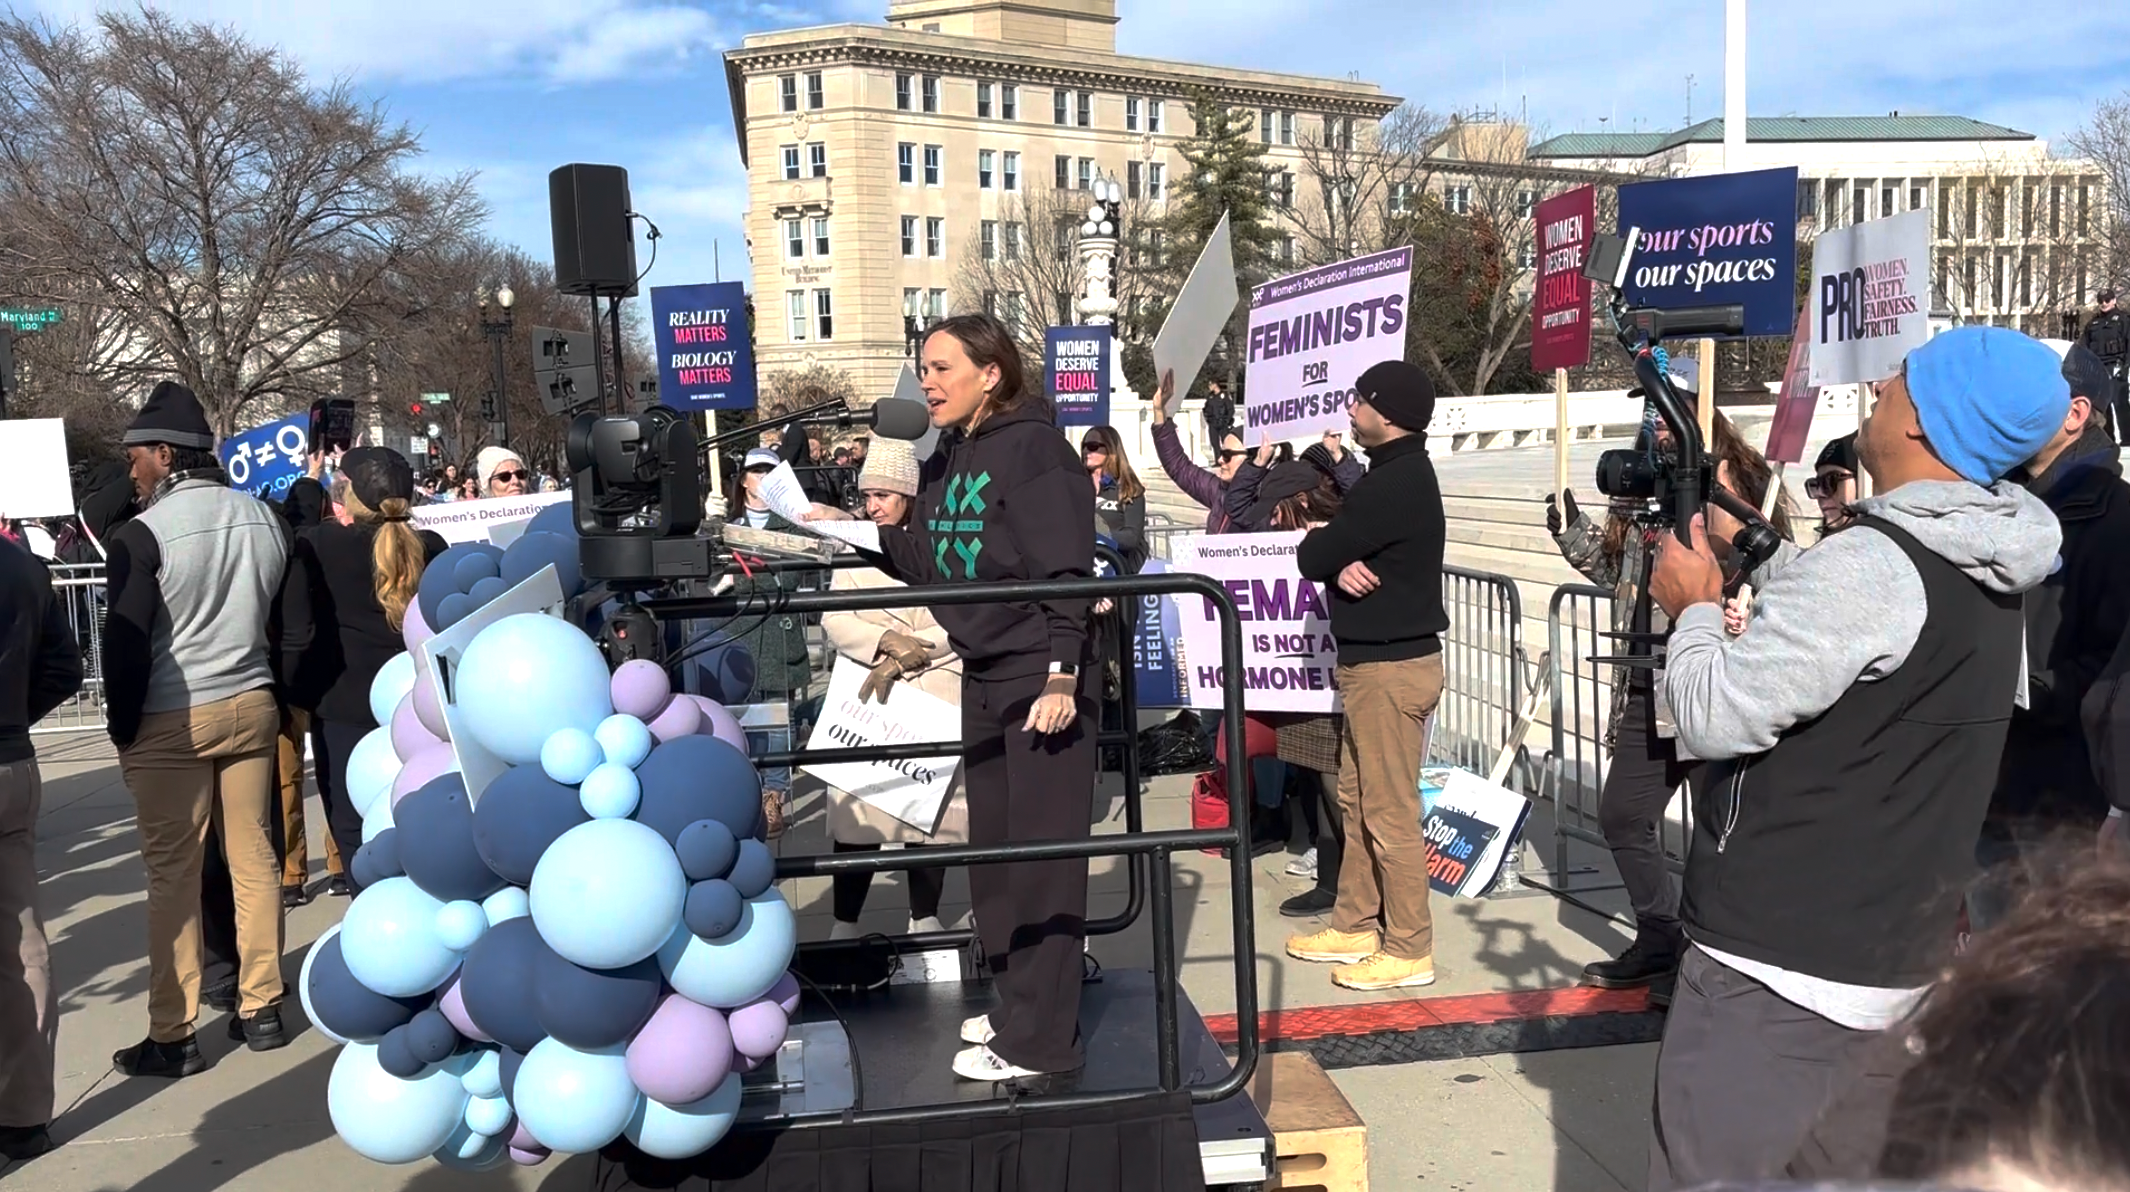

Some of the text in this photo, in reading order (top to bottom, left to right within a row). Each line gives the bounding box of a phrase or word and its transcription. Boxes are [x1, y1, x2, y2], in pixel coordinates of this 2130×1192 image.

[1544, 214, 1583, 250] WOMEN
[1687, 217, 1774, 257] sports
[1544, 245, 1583, 276] DESERVE
[1864, 258, 1909, 282] WOMEN.
[1270, 253, 1405, 298] Women's Declaration International
[1635, 257, 1777, 293] our spaces
[1543, 272, 1581, 310] EQUAL
[1864, 278, 1907, 301] SAFETY.
[1, 311, 46, 322] Maryland
[669, 308, 730, 326] REALITY
[1821, 267, 1865, 344] PRO
[1864, 296, 1918, 320] FAIRNESS.
[21, 322, 38, 330] 100
[1249, 294, 1404, 364] FEMINISTS
[1542, 307, 1581, 330] OPPORTUNITY
[1864, 318, 1900, 339] TRUTH.
[674, 326, 727, 344] MATTERS
[671, 350, 737, 369] BIOLOGY
[1056, 340, 1099, 356] WOMEN
[1055, 357, 1099, 371] DESERVE
[1303, 361, 1328, 382] FOR
[679, 367, 732, 386] MATTERS
[1055, 372, 1098, 392] EQUAL
[1055, 392, 1099, 403] OPPORTUNITY
[1248, 387, 1358, 428] WOMEN'S SPO
[418, 503, 545, 527] Women's Declaratio
[1198, 546, 1249, 559] Women's
[1202, 578, 1335, 622] EMA
[1144, 594, 1164, 671] FEELING
[1252, 634, 1336, 653] IS NOT A
[1176, 637, 1189, 698] INFORMED
[828, 724, 936, 785] our aces
[1423, 815, 1473, 860] Stop the
